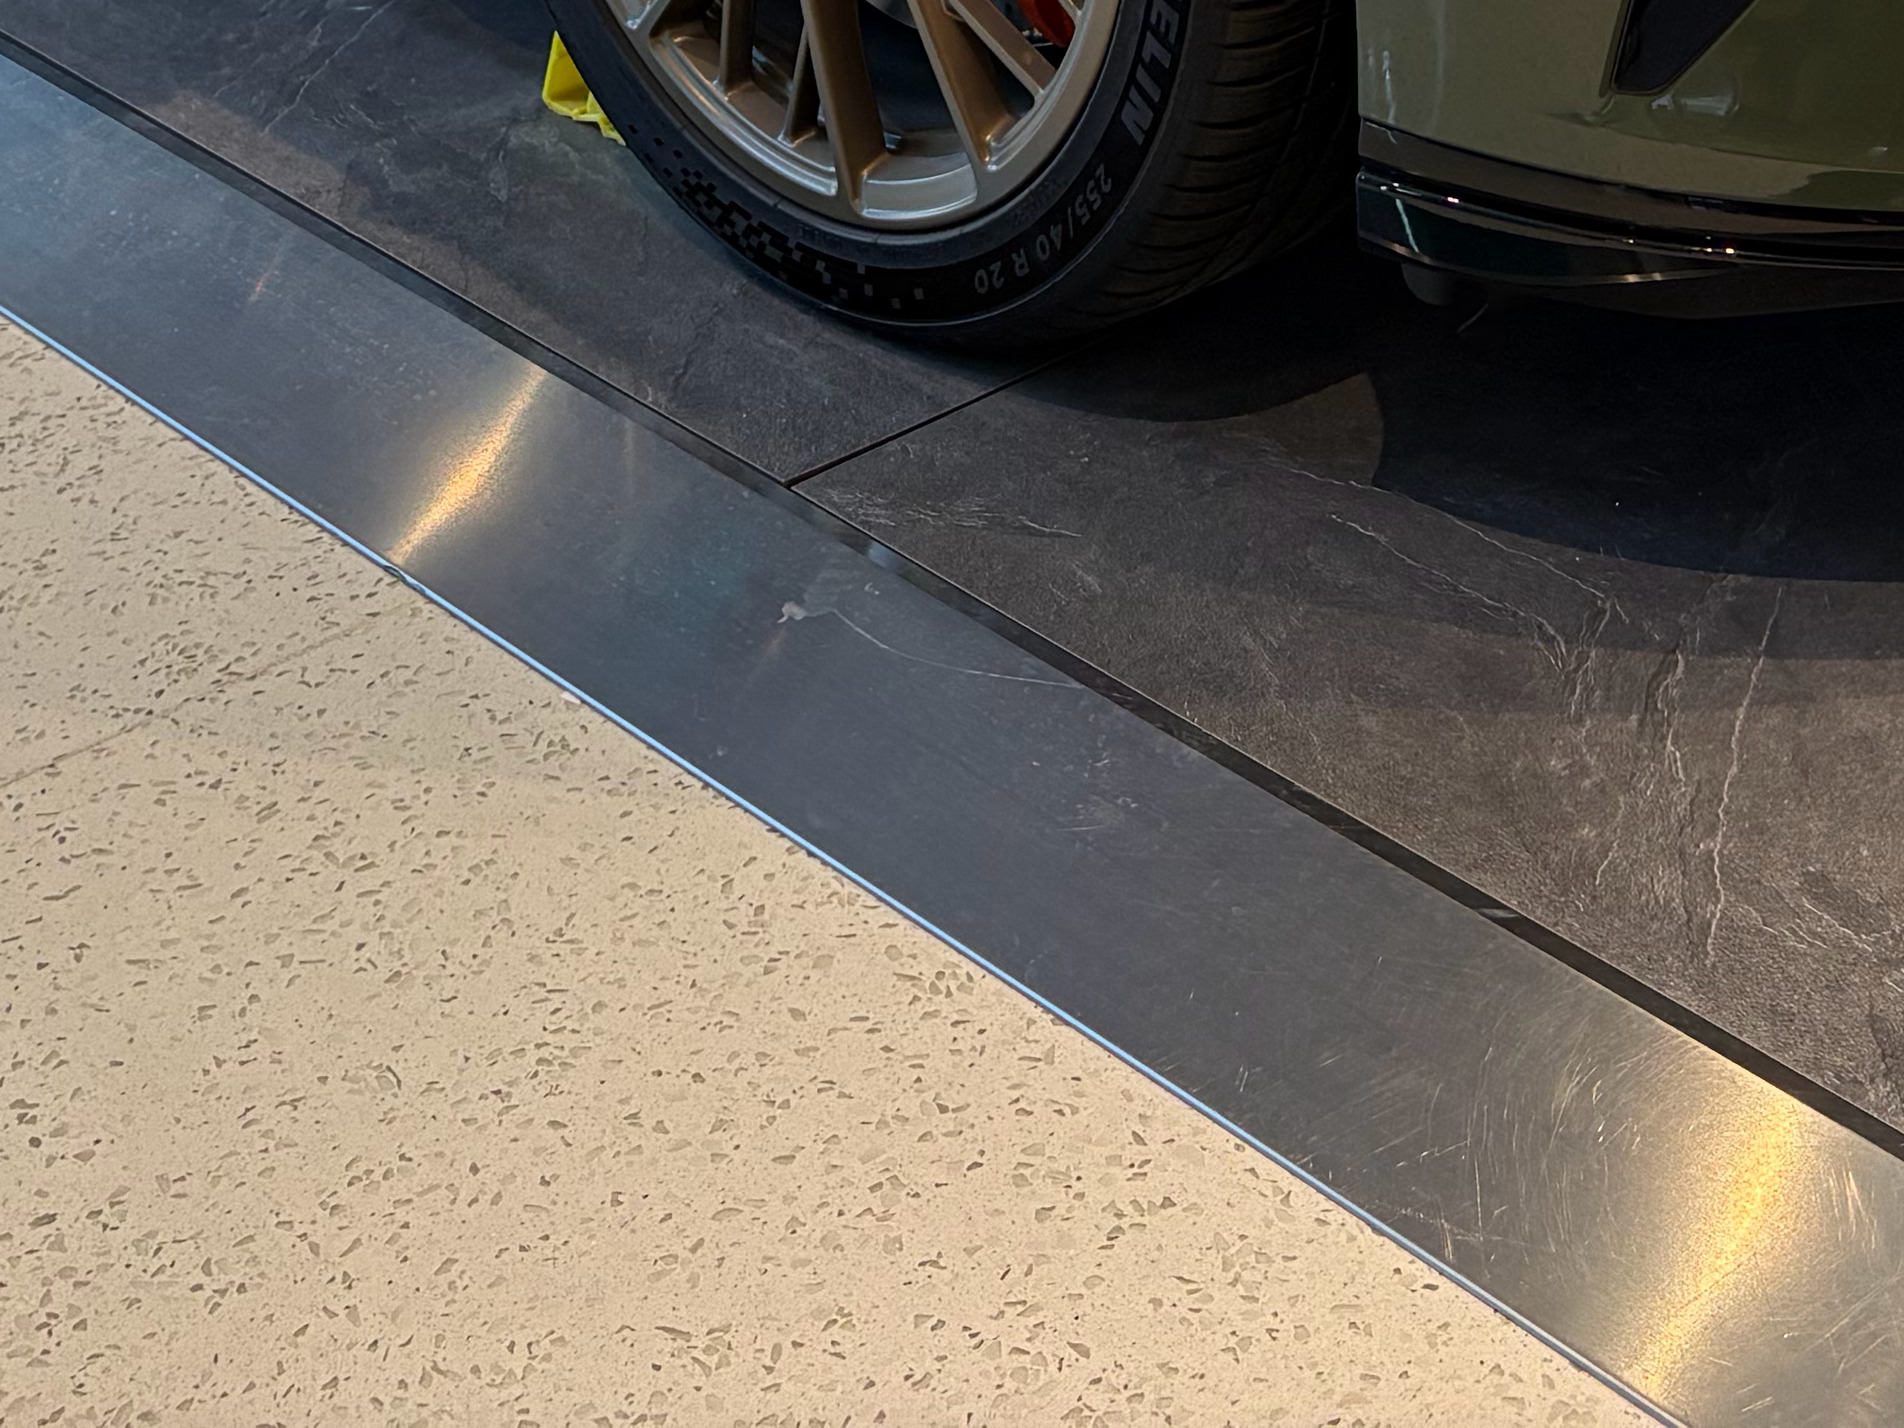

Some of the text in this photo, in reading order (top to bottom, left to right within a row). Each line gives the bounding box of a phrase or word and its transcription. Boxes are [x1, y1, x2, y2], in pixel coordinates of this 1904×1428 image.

[1035, 162, 1113, 262] 255/40
[974, 260, 1005, 295] 20
[1010, 246, 1030, 278] R
